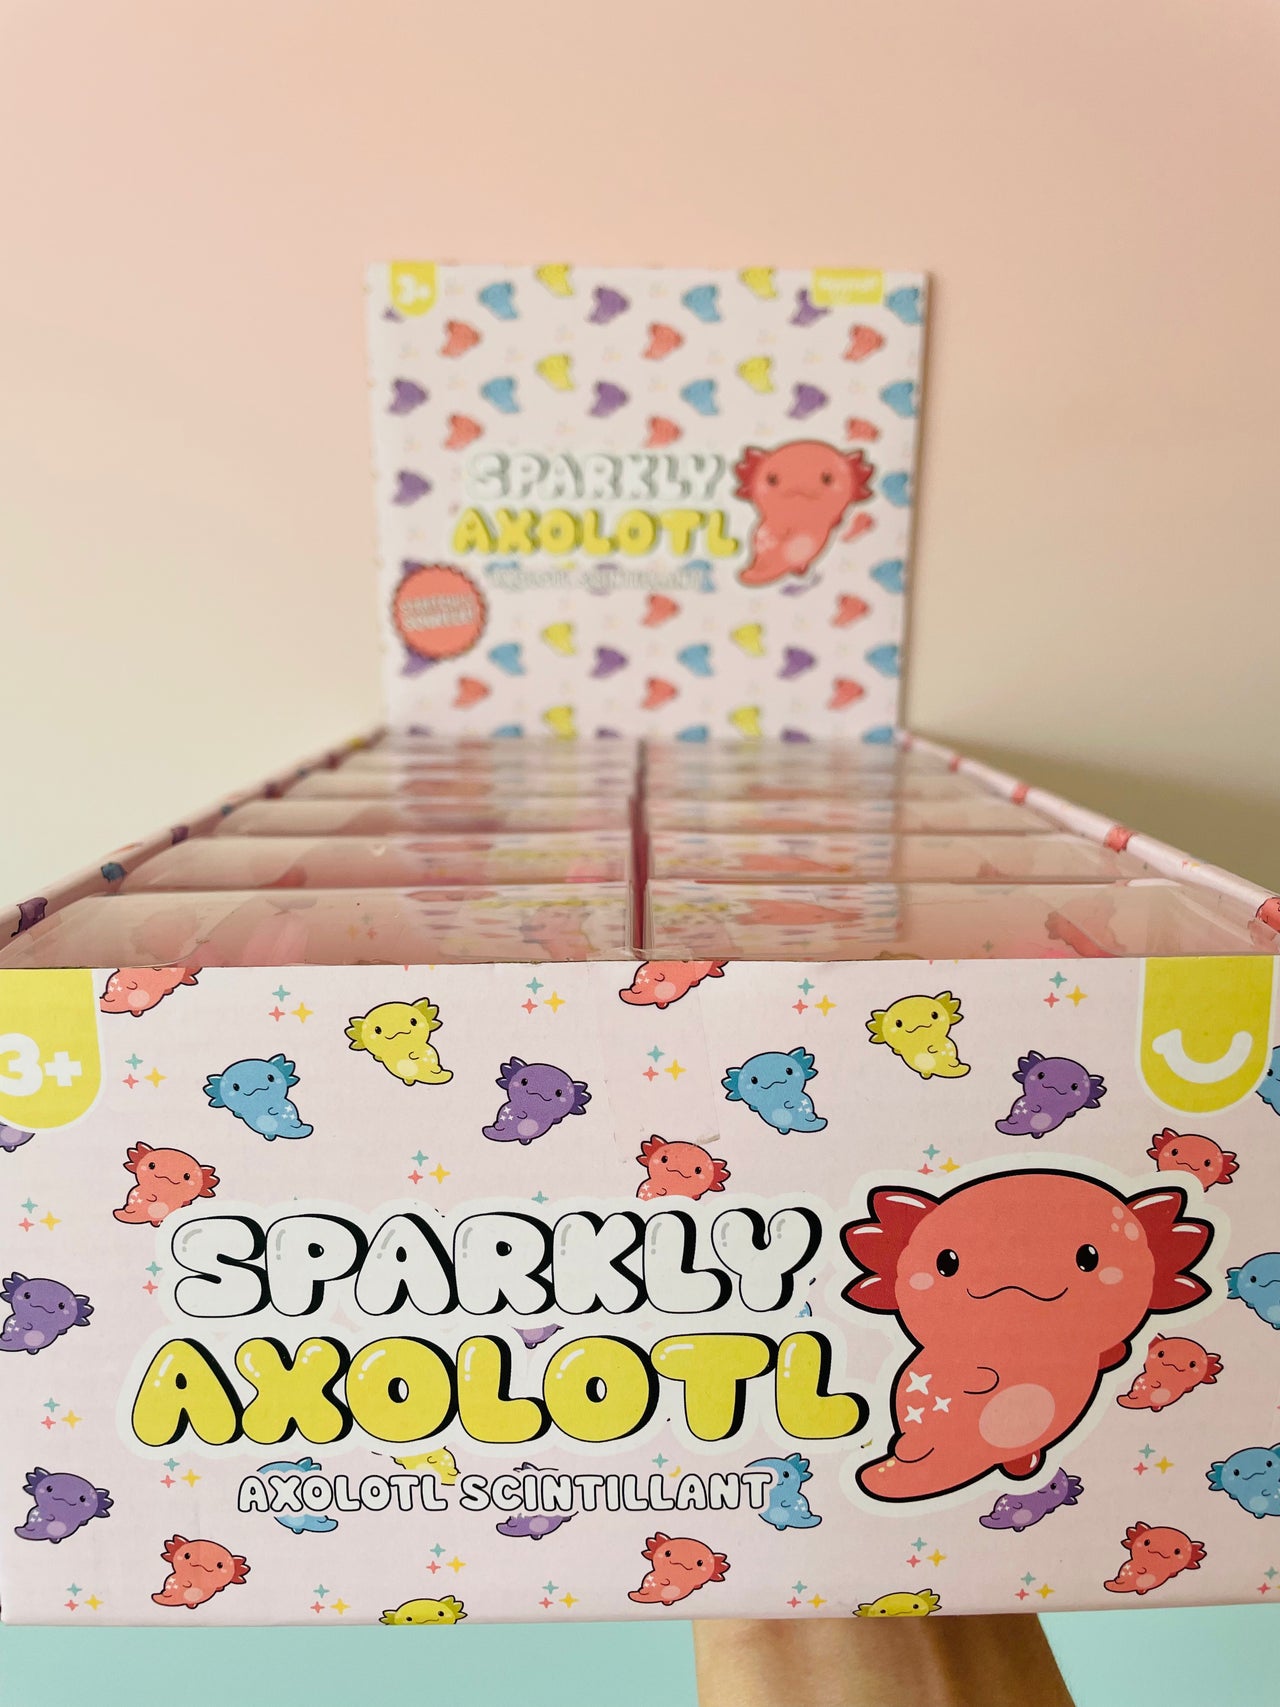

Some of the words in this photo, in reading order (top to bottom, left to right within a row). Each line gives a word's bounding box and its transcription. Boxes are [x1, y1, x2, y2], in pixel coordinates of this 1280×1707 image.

[465, 452, 728, 500] SPARKLY
[452, 507, 740, 556] AXOLOTL
[0, 1033, 82, 1097] 3+
[172, 1208, 822, 1317] SPARKLY
[131, 1331, 869, 1445] AXOLOTL
[237, 1474, 448, 1512] AXOLOTL
[460, 1474, 773, 1512] SCINTILLANT
